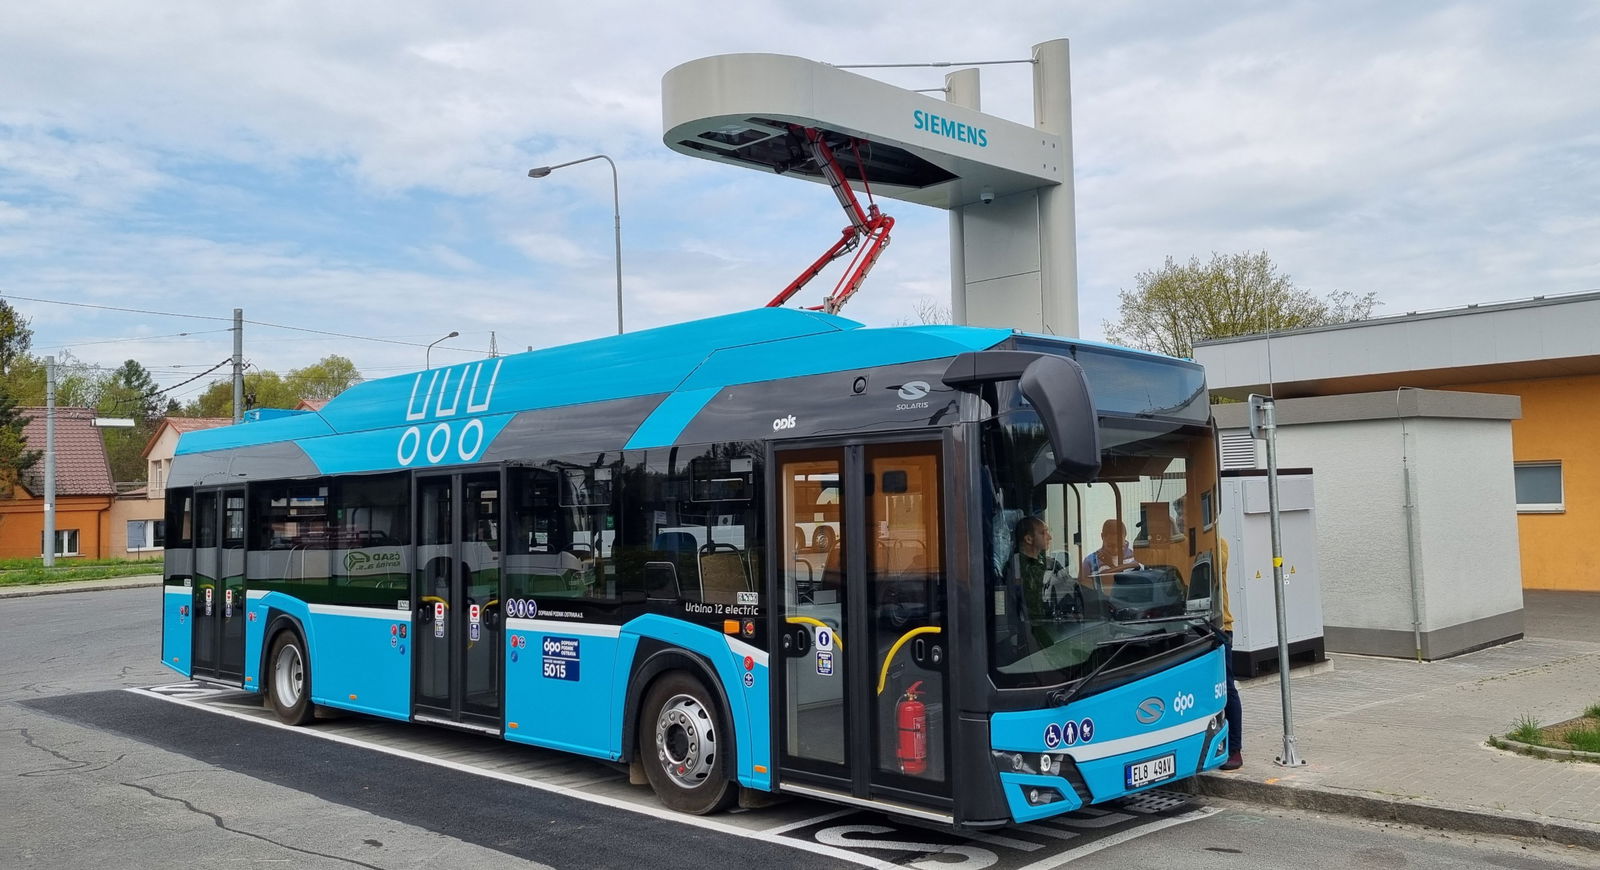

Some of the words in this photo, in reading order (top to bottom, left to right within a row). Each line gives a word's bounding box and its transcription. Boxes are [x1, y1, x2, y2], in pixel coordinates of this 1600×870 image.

[913, 109, 988, 148] SIEMENS
[896, 402, 929, 411] SOLARIS
[685, 602, 713, 614] Urbino
[714, 604, 723, 614] 12
[725, 604, 759, 616] electric
[544, 638, 560, 655] dpo
[544, 664, 566, 678] 5015
[1174, 691, 1194, 716] dpo
[1133, 764, 1148, 782] EL8
[1154, 758, 1171, 776] 49AV
